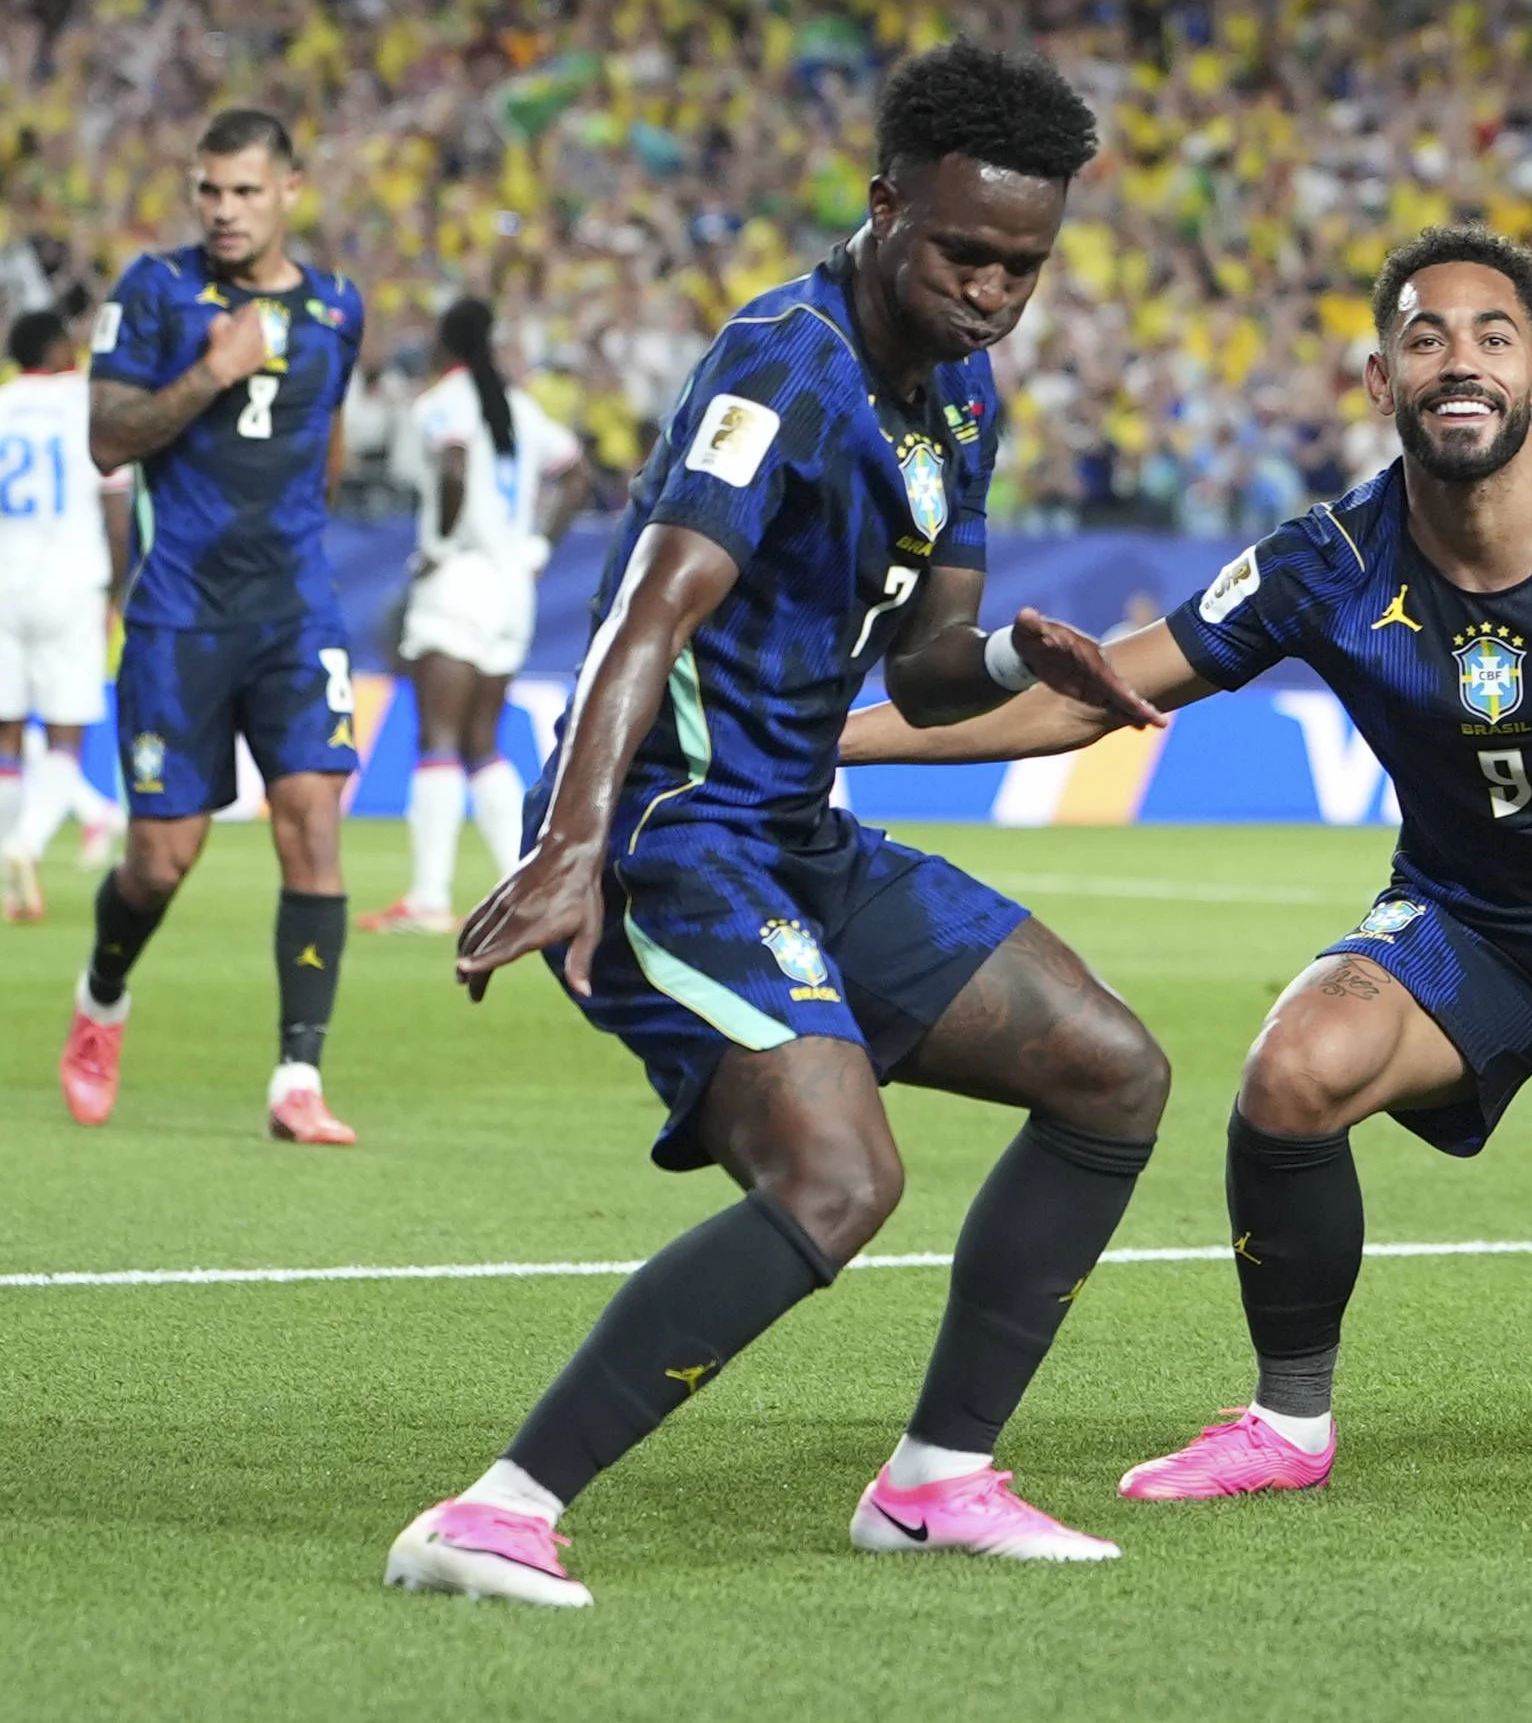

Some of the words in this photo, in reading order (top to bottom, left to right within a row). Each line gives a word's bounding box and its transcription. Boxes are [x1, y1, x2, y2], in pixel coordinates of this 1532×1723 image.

[237, 374, 280, 439] 8
[0, 434, 65, 516] 21
[850, 565, 921, 659] 7
[318, 648, 354, 714] 8
[1478, 670, 1504, 682] CBF
[1460, 722, 1532, 736] BRASIL
